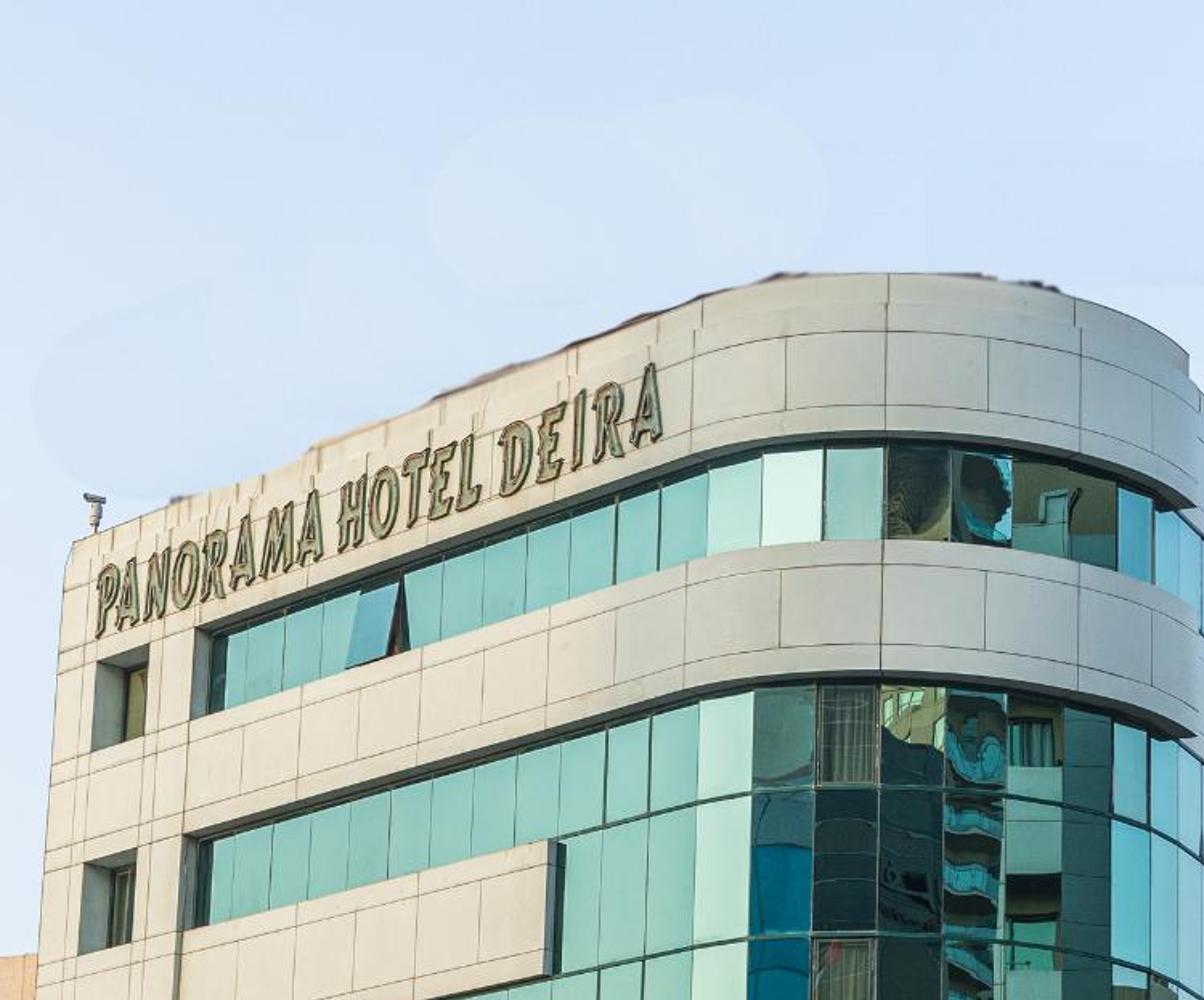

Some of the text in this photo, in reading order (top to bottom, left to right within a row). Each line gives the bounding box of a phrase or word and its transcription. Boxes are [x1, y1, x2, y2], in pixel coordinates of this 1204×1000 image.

[96, 362, 664, 639] PANORAMA HOTEL DEIRA
